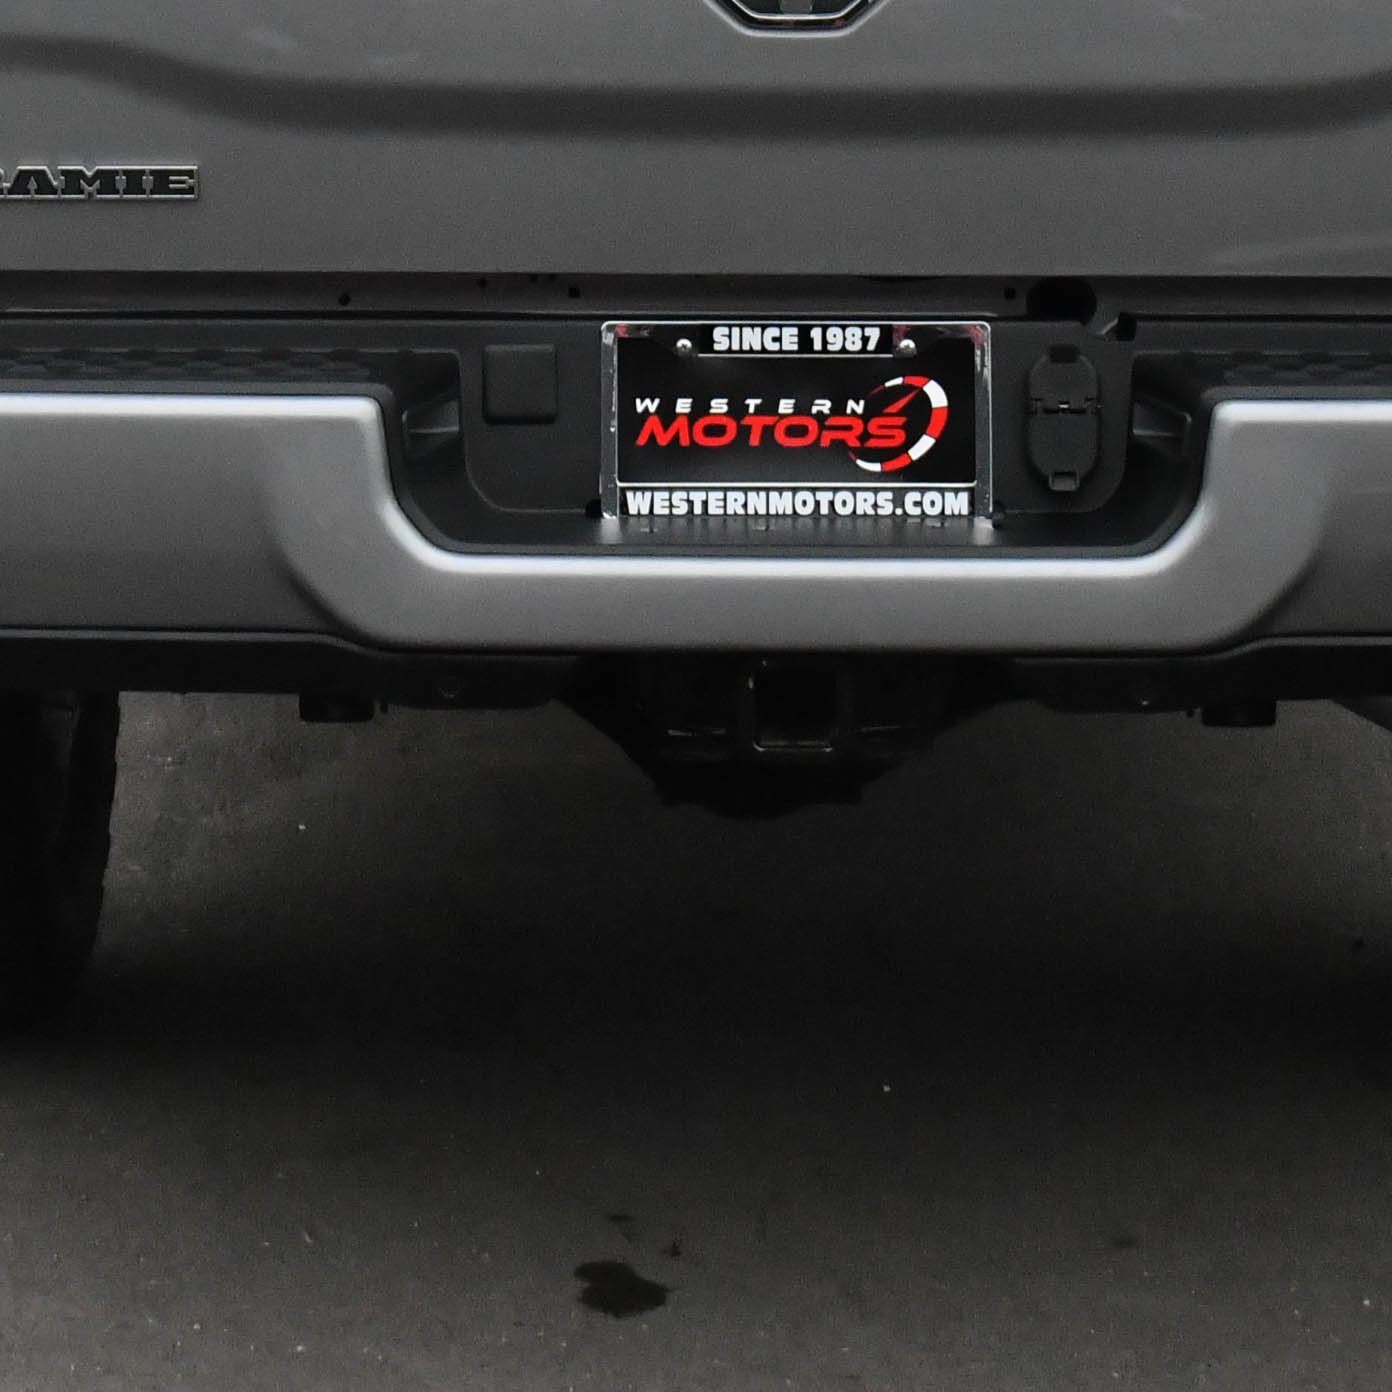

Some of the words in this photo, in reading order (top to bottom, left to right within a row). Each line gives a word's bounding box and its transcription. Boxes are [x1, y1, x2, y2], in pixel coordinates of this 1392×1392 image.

[712, 326, 799, 352] SINCE
[809, 326, 881, 352] 1987
[635, 397, 865, 415] WESTERN
[635, 414, 908, 448] MOTORS
[626, 490, 969, 517] WESTERNMOTORS.COM
